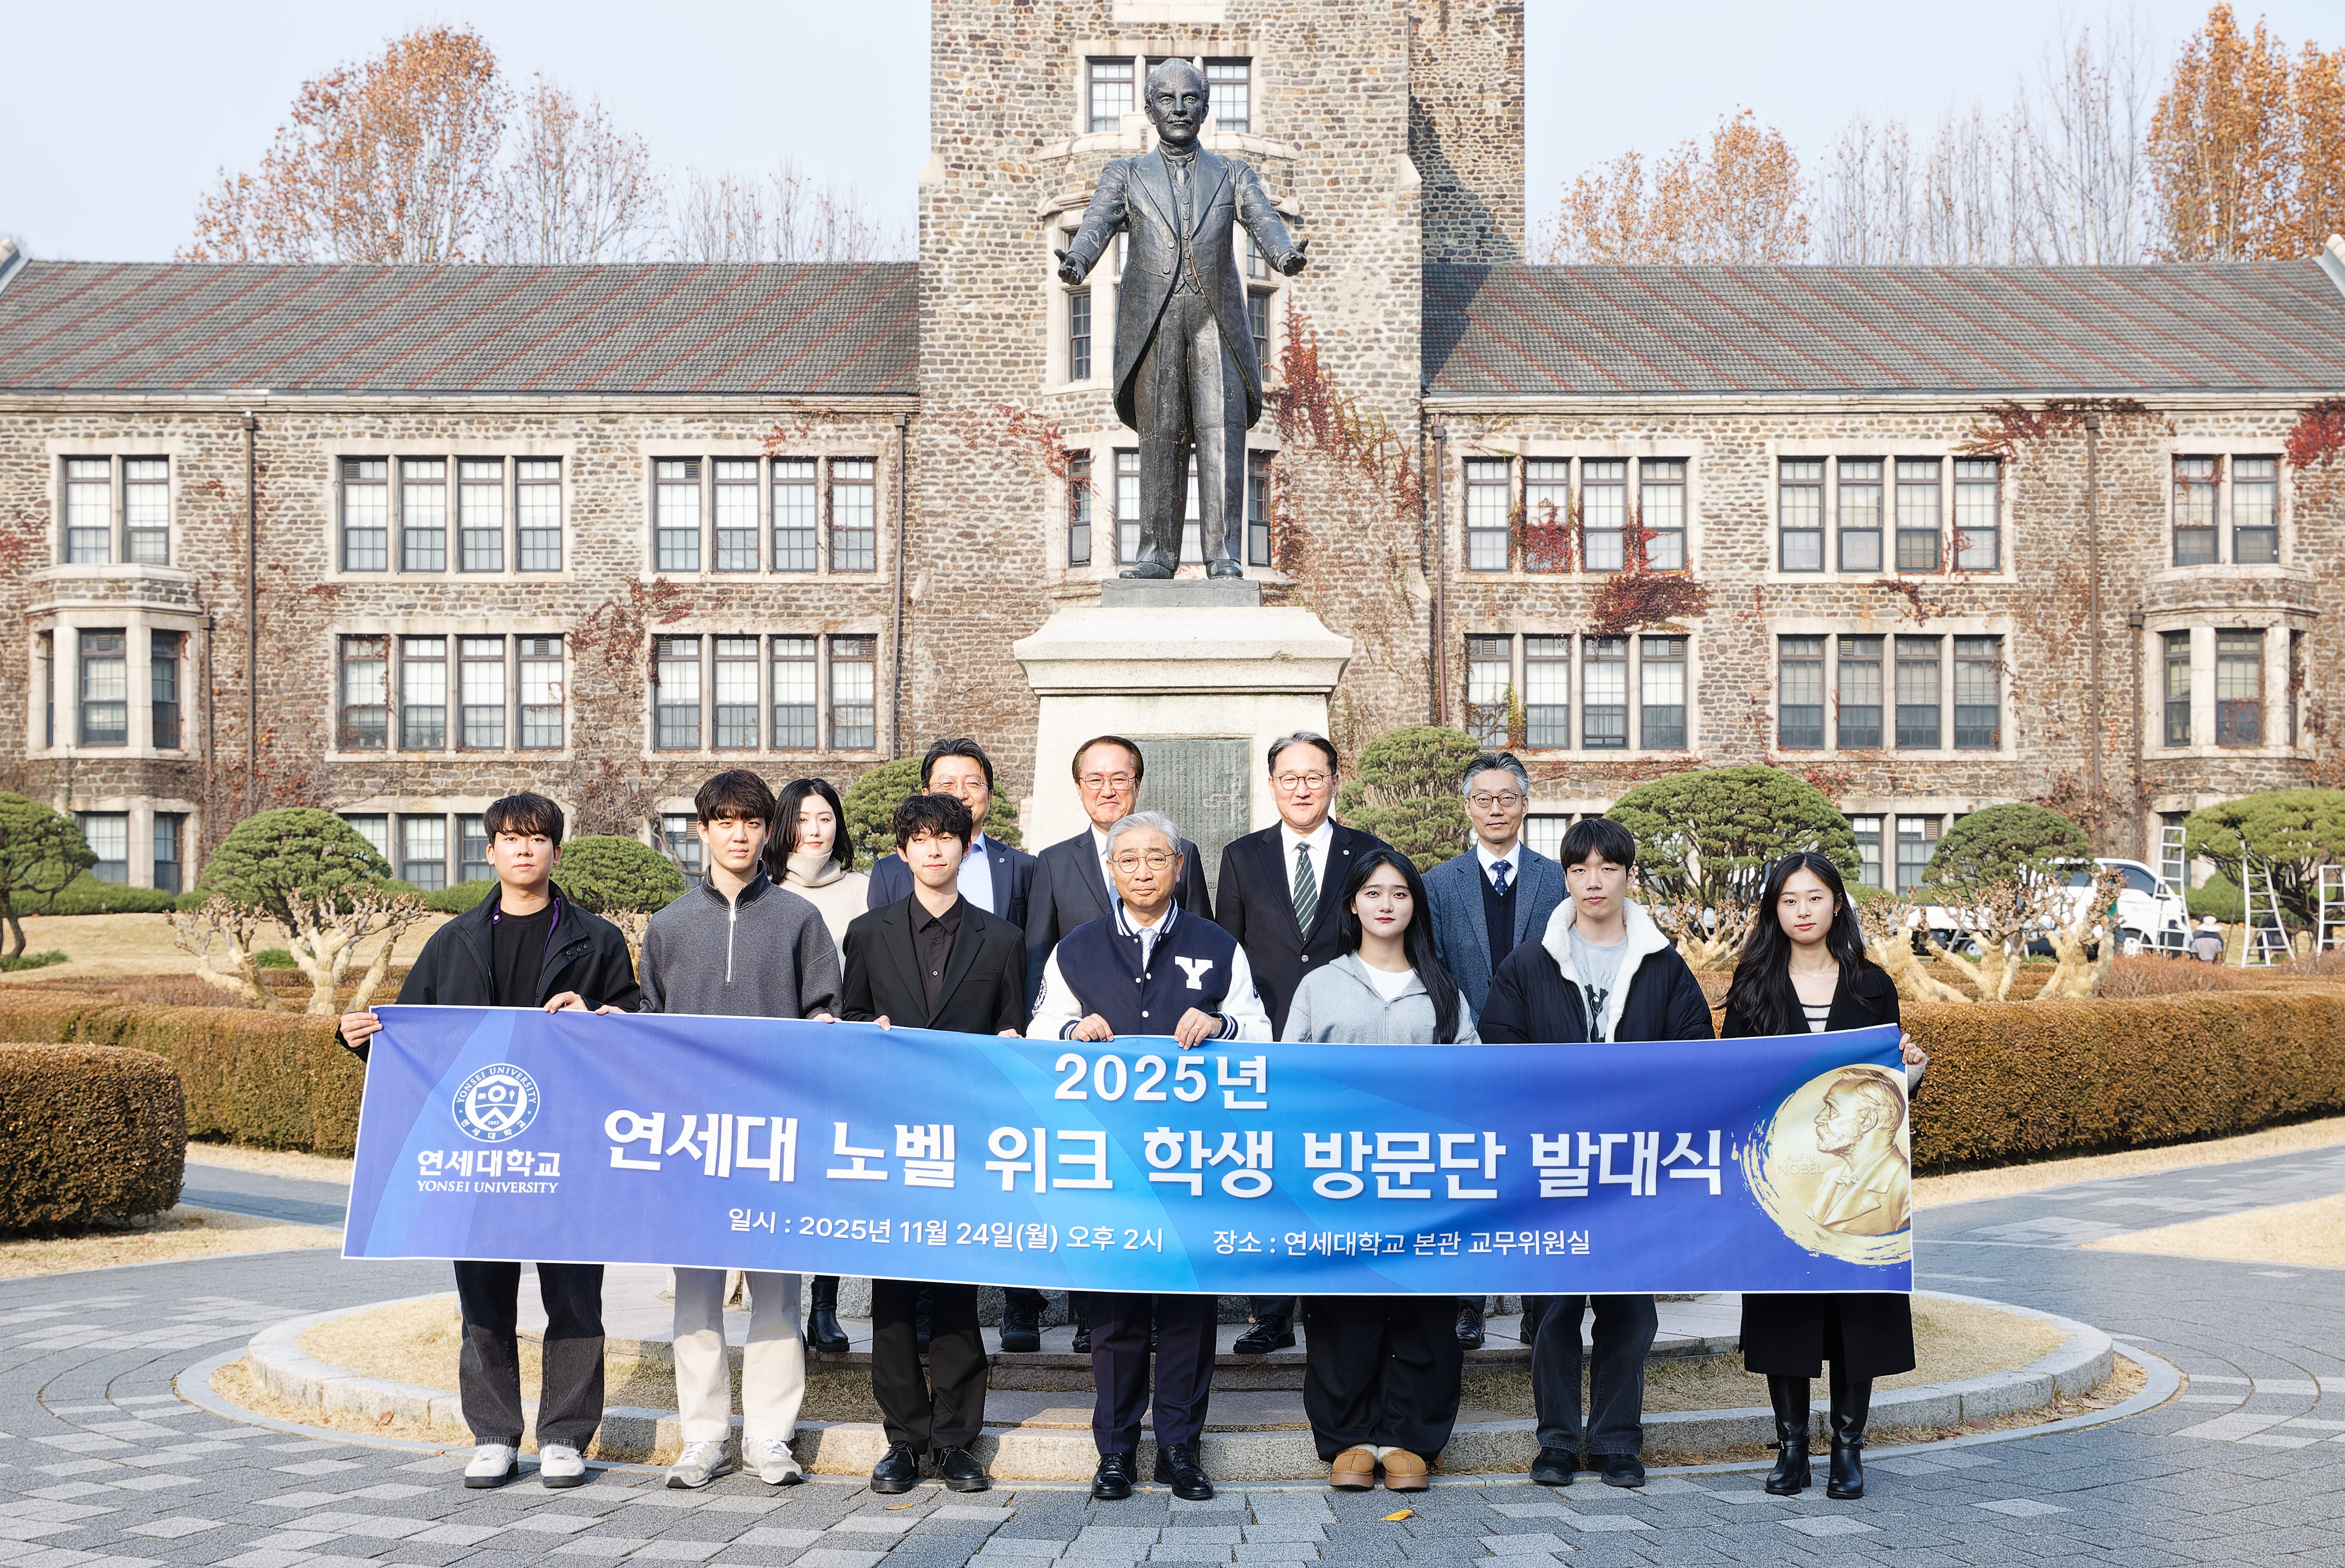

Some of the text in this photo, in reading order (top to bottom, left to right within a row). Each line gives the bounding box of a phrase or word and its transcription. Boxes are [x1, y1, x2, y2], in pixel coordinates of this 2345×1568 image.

[1174, 956, 1213, 990] Y
[456, 1066, 537, 1104] YONSEI UNIVERSITY
[1054, 1053, 1268, 1110] 2025년
[460, 1118, 527, 1140] 연세대학교
[417, 1148, 561, 1178] 연세대학교
[604, 1109, 1722, 1199] 연세대 노벨 위크 학생 방문단 발대식
[1778, 1163, 1825, 1176] NOBEL
[416, 1180, 560, 1194] YONSEI UNIVERSITY
[728, 1208, 1163, 1253] 일시 : 2025년 11월 24일(월) 오후 2시
[1213, 1230, 1591, 1256] 장소 : 연세대학교 본관 교무위원실
